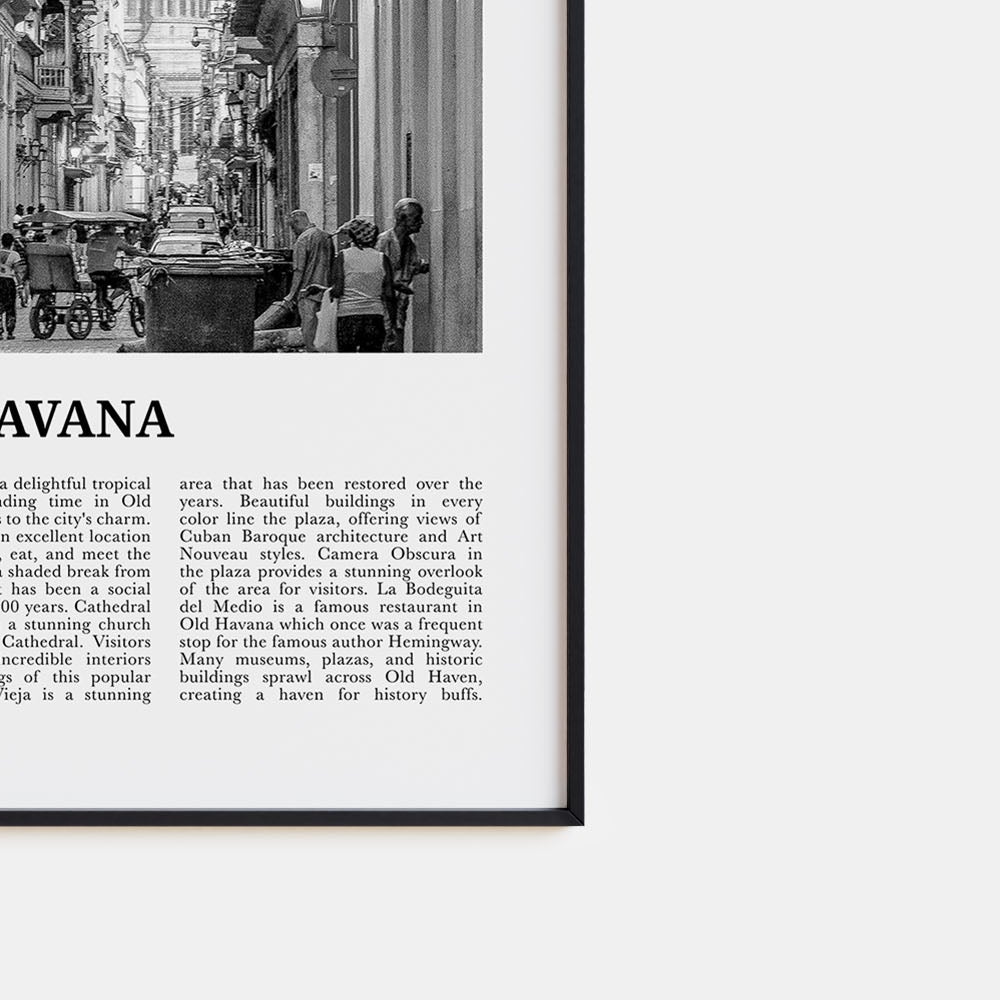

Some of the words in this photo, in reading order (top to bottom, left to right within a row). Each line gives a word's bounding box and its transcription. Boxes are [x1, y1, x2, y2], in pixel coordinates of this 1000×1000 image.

[0, 481, 8, 490] a
[14, 476, 86, 494] delightful
[93, 477, 150, 494] tropical
[180, 481, 212, 490] area
[223, 477, 252, 490] that
[263, 477, 288, 490] has
[298, 477, 334, 490] been
[345, 476, 406, 490] restored
[416, 481, 449, 490] over
[459, 477, 482, 490] the
[7, 515, 21, 525] to
[26, 512, 49, 525] the
[54, 512, 92, 529] city's
[97, 512, 150, 525] charm.
[180, 512, 219, 525] color
[227, 512, 254, 525] line
[263, 512, 286, 525] the
[295, 512, 340, 529] plaza,
[349, 512, 409, 529] offering
[416, 512, 457, 525] views
[466, 512, 481, 525] of
[10, 550, 37, 563] eat,
[46, 547, 74, 560] and
[83, 550, 119, 560] meet
[128, 547, 150, 560] the
[180, 547, 247, 560] Nouveau
[260, 547, 304, 564] styles.
[318, 547, 379, 560] Camera
[391, 547, 456, 560] Obscura
[468, 547, 482, 560] in
[12, 582, 36, 595] has
[45, 582, 81, 595] been
[91, 586, 99, 595] a
[108, 582, 150, 595] social
[180, 582, 195, 595] of
[206, 582, 229, 595] the
[238, 586, 270, 595] area
[280, 582, 301, 595] for
[309, 582, 367, 595] visitors.
[377, 582, 396, 595] La
[406, 582, 482, 599] Bodeguita
[8, 621, 16, 630] a
[25, 617, 91, 634] stunning
[99, 617, 150, 630] church
[180, 617, 209, 630] Old
[215, 617, 274, 630] Havana
[280, 617, 324, 630] which
[330, 621, 365, 630] once
[371, 621, 399, 630] was
[405, 621, 412, 630] a
[419, 617, 482, 634] frequent
[2, 635, 83, 648] Cathedral.
[94, 635, 151, 648] Visitors
[180, 652, 224, 669] Many
[236, 656, 310, 668] museums,
[322, 652, 373, 669] plazas,
[386, 652, 414, 665] and
[426, 652, 482, 665] historic
[43, 688, 54, 700] is
[65, 692, 73, 700] a
[85, 687, 151, 704] stunning
[180, 688, 242, 704] creating
[256, 692, 264, 700] a
[280, 688, 323, 701] haven
[339, 687, 360, 700] for
[375, 687, 427, 704] history
[442, 687, 482, 701] buffs.
